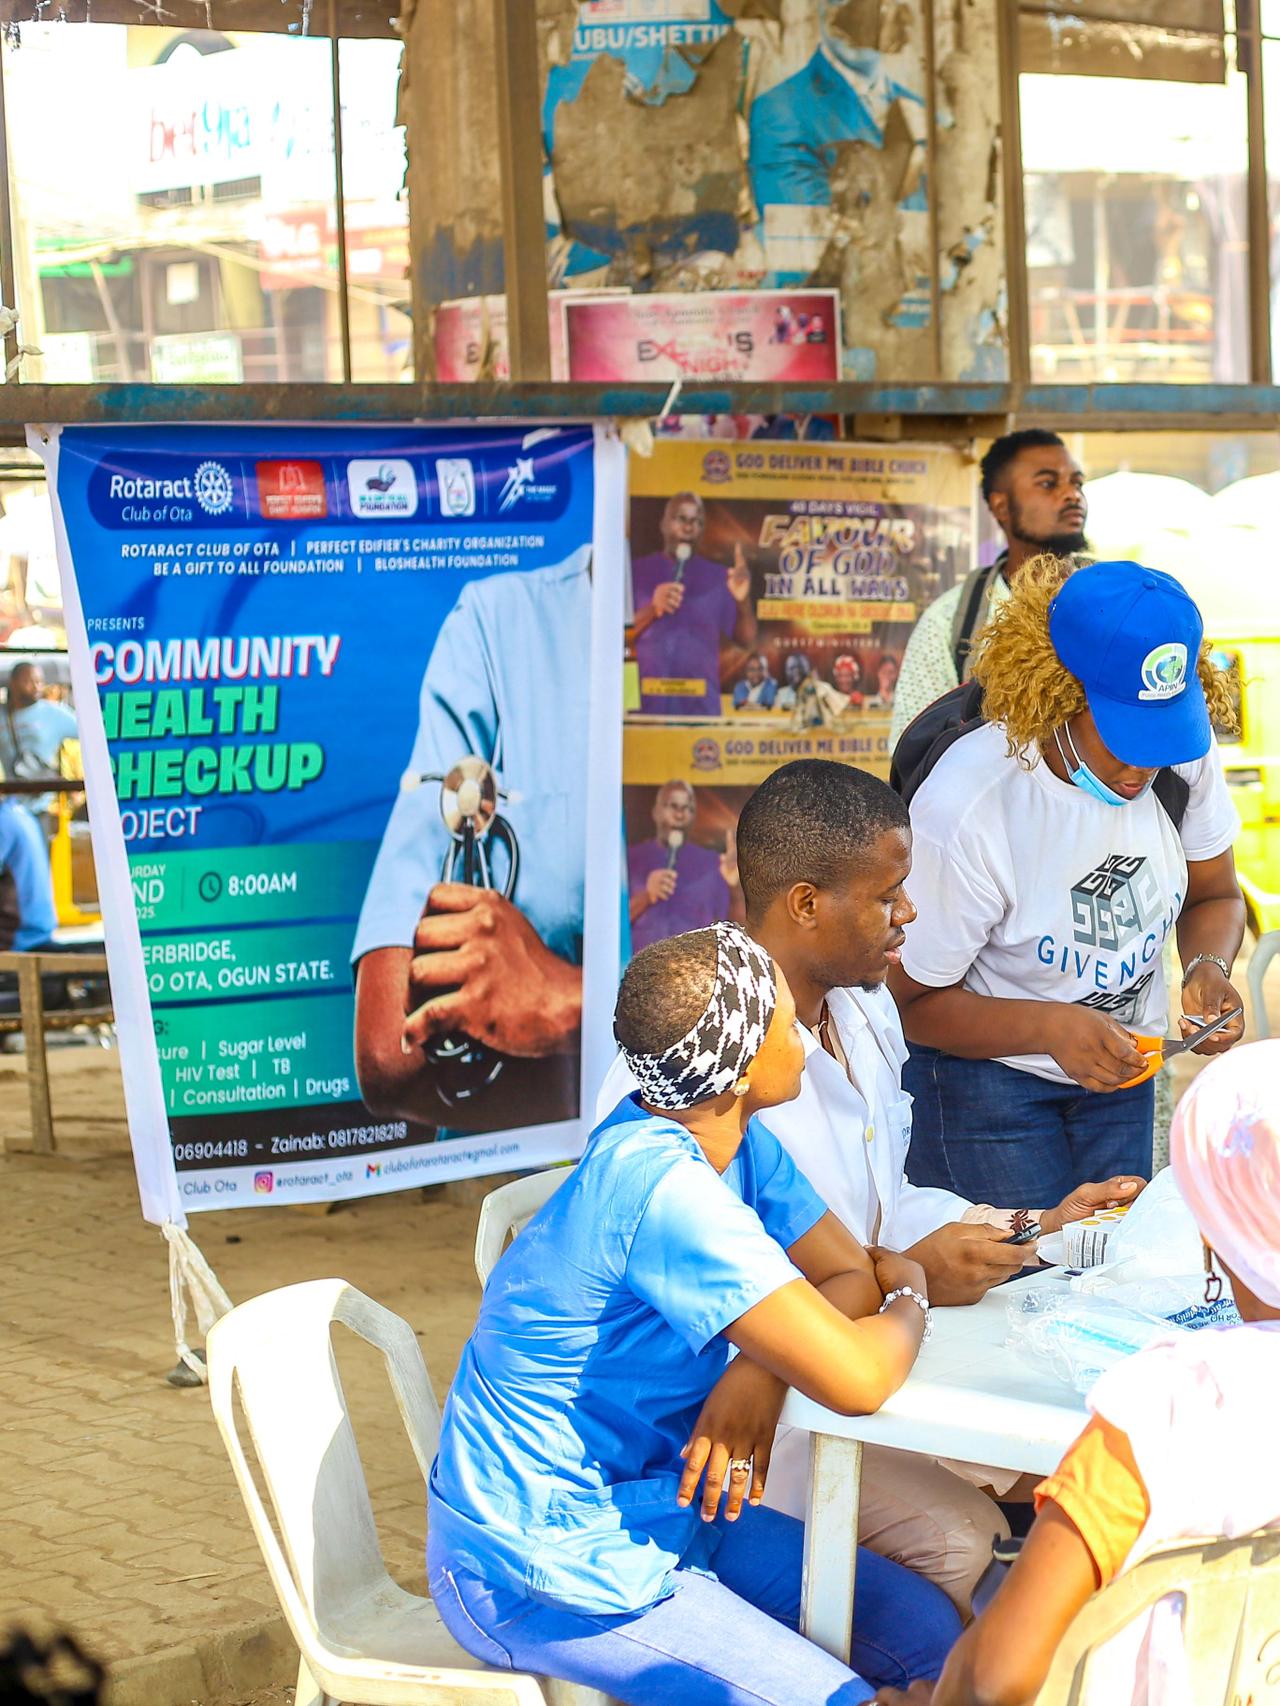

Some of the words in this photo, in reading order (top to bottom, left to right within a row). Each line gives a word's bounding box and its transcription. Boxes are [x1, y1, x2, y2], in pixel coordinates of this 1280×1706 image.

[735, 454, 764, 469] GOD
[768, 455, 821, 470] DELIVER
[827, 457, 844, 471] ME
[849, 457, 884, 473] BIBLE
[110, 475, 192, 498] Rotaract
[121, 505, 150, 522] Club
[153, 504, 167, 521] of
[170, 504, 193, 522] Ota
[808, 501, 843, 514] DAYS
[758, 514, 916, 552] FAVOUR
[121, 543, 193, 558] ROTARACT
[196, 543, 230, 557] CLUB
[233, 543, 250, 556] OF
[253, 542, 279, 556] OTA
[306, 540, 355, 554] PERFECT
[358, 538, 410, 554] EDIFIER'S
[413, 537, 461, 552] CHARITY
[464, 535, 545, 549] ORGANIZATION
[153, 562, 168, 576] BE
[172, 561, 182, 575] A
[185, 560, 213, 575] GIFT
[217, 560, 235, 574] TO
[238, 560, 260, 575] ALL
[263, 557, 344, 574] FOUNDATION
[448, 553, 518, 569] FOUNDATION
[779, 547, 826, 575] OF
[832, 549, 898, 577] GOD
[764, 573, 793, 599] IN
[802, 574, 842, 597] ALL
[849, 576, 909, 600] WAYS
[87, 617, 145, 631] PRESENTS
[90, 634, 341, 684] COMMUNITY
[725, 740, 754, 756] GOD
[759, 739, 813, 755] DELIVER
[817, 738, 834, 754] ME
[839, 737, 873, 753] BIBLE
[112, 741, 324, 800] HECKUP
[228, 872, 298, 896] 8:00AM
[169, 971, 213, 991] OTA,
[217, 965, 271, 988] OGUN
[275, 960, 334, 983] STATE.
[219, 1038, 264, 1060] Sugar
[268, 1032, 306, 1053] Level
[176, 1067, 203, 1083] HIV
[207, 1064, 240, 1081] Test
[272, 1057, 291, 1075] TB
[183, 1082, 286, 1105] Consultation
[306, 1077, 350, 1098] Drugs
[270, 1134, 327, 1154] Zainab:
[184, 1180, 211, 1196] Club
[215, 1180, 238, 1193] Ota
